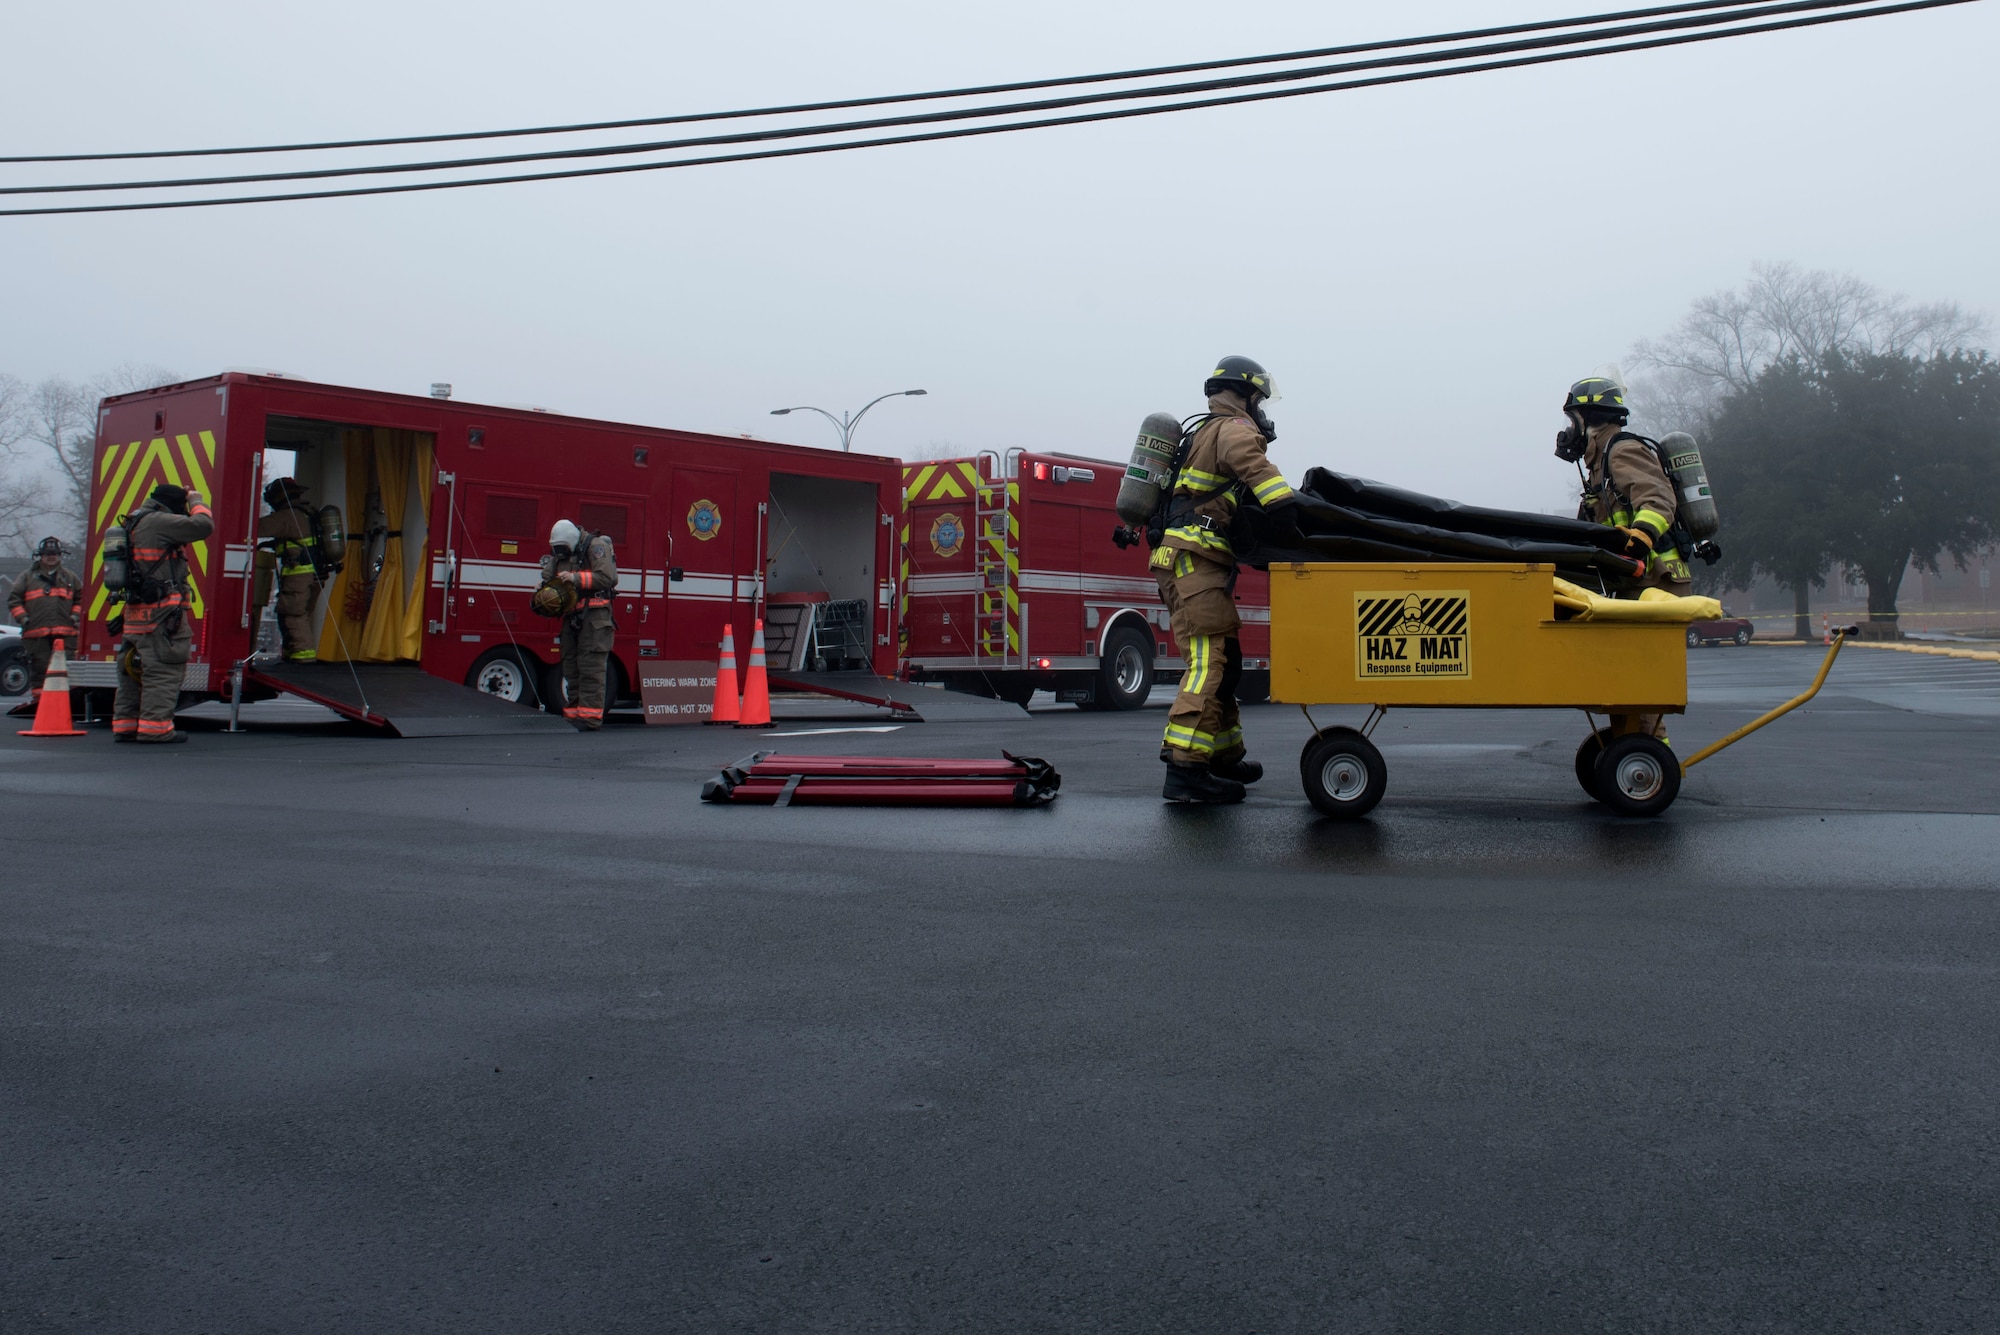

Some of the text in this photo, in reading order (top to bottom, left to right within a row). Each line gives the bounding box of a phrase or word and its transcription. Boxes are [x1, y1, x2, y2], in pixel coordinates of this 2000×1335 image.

[1151, 440, 1174, 454] MSA
[1675, 454, 1700, 467] MSA
[1367, 636, 1462, 661] HAZ MAT
[1367, 661, 1463, 674] Response Equipment
[643, 677, 717, 687] ENTERING WARM ZONE
[648, 704, 714, 715] EXITING HOT ZON
